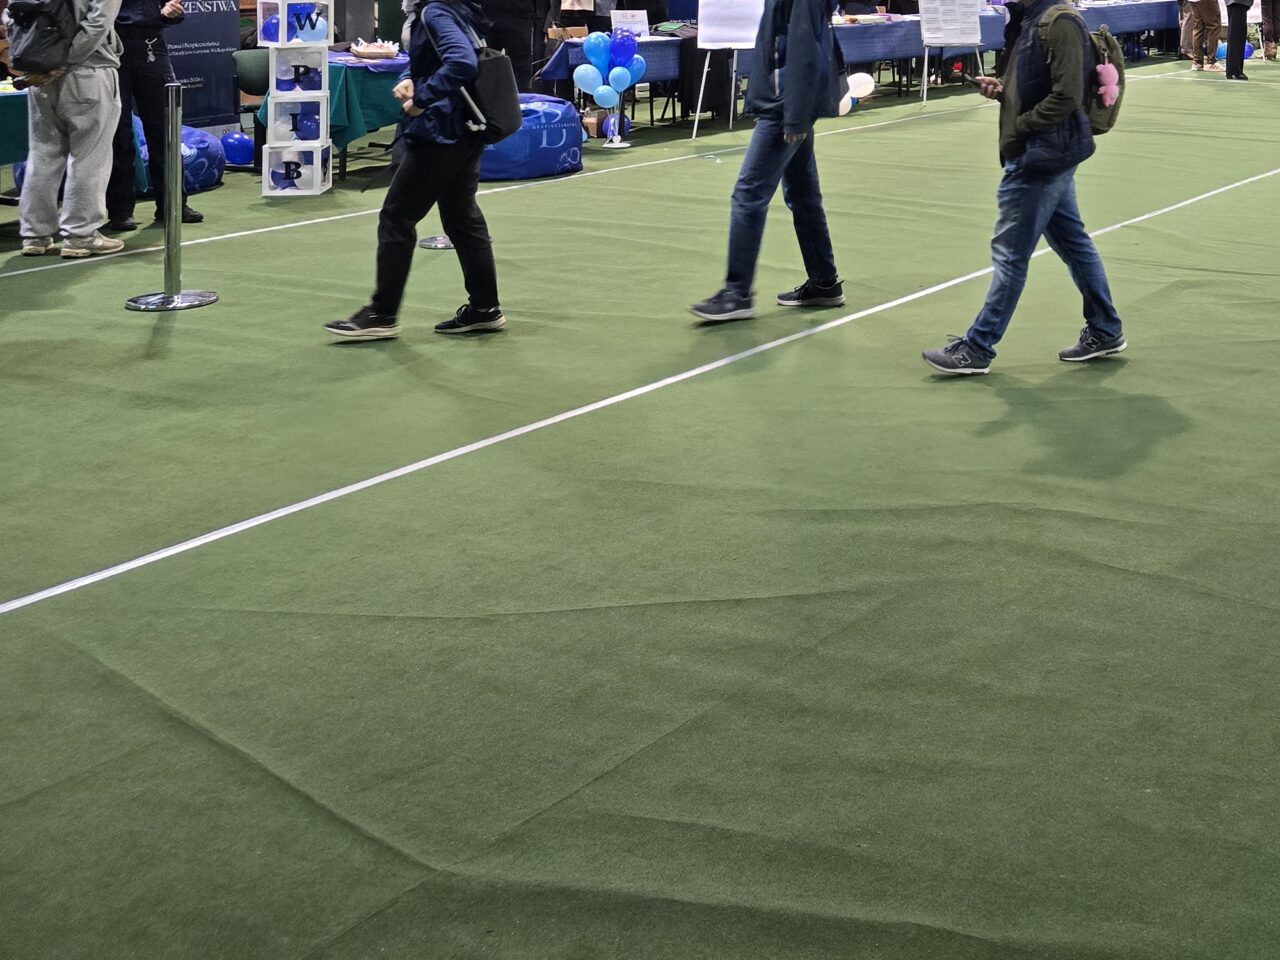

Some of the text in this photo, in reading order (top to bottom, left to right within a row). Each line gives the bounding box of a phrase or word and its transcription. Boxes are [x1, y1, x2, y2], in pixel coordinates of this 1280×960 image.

[294, 12, 322, 31] W
[290, 64, 310, 84] P
[289, 113, 299, 132] I
[282, 161, 302, 181] B
